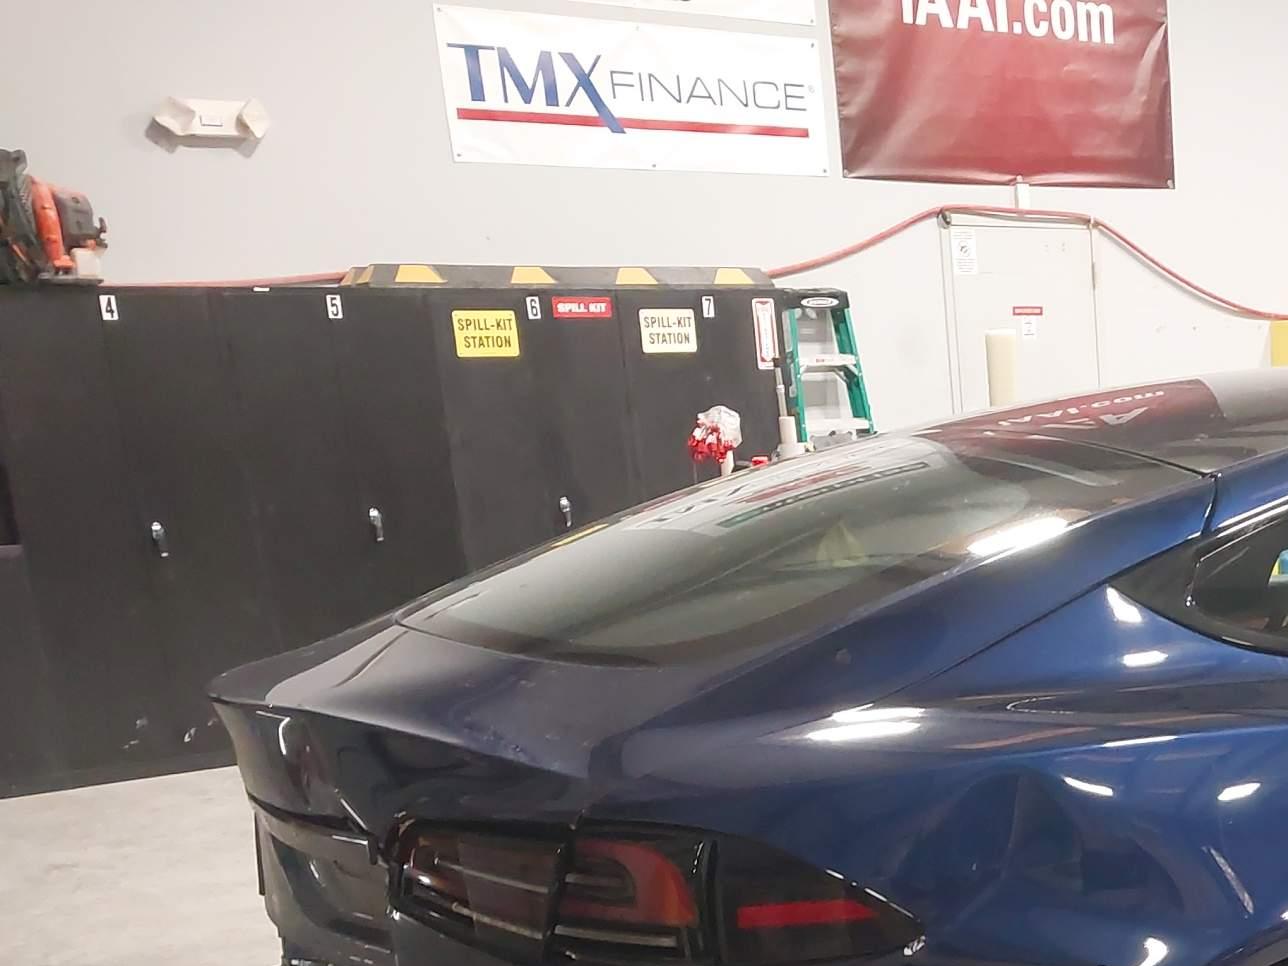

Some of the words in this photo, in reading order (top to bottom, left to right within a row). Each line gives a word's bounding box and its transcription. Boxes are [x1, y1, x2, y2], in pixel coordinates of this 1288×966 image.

[446, 42, 626, 134] TMX
[609, 70, 808, 112] FINANCE
[105, 296, 115, 319] 4
[331, 297, 340, 317] 5
[529, 297, 540, 318] 6
[556, 302, 588, 313] SPILL
[588, 302, 607, 313] KIT
[704, 297, 713, 316] 7
[457, 318, 513, 332] SPILL-KIT
[643, 315, 692, 330] SPILL-KIT
[463, 335, 512, 349] STATION
[648, 332, 690, 346] STATION
